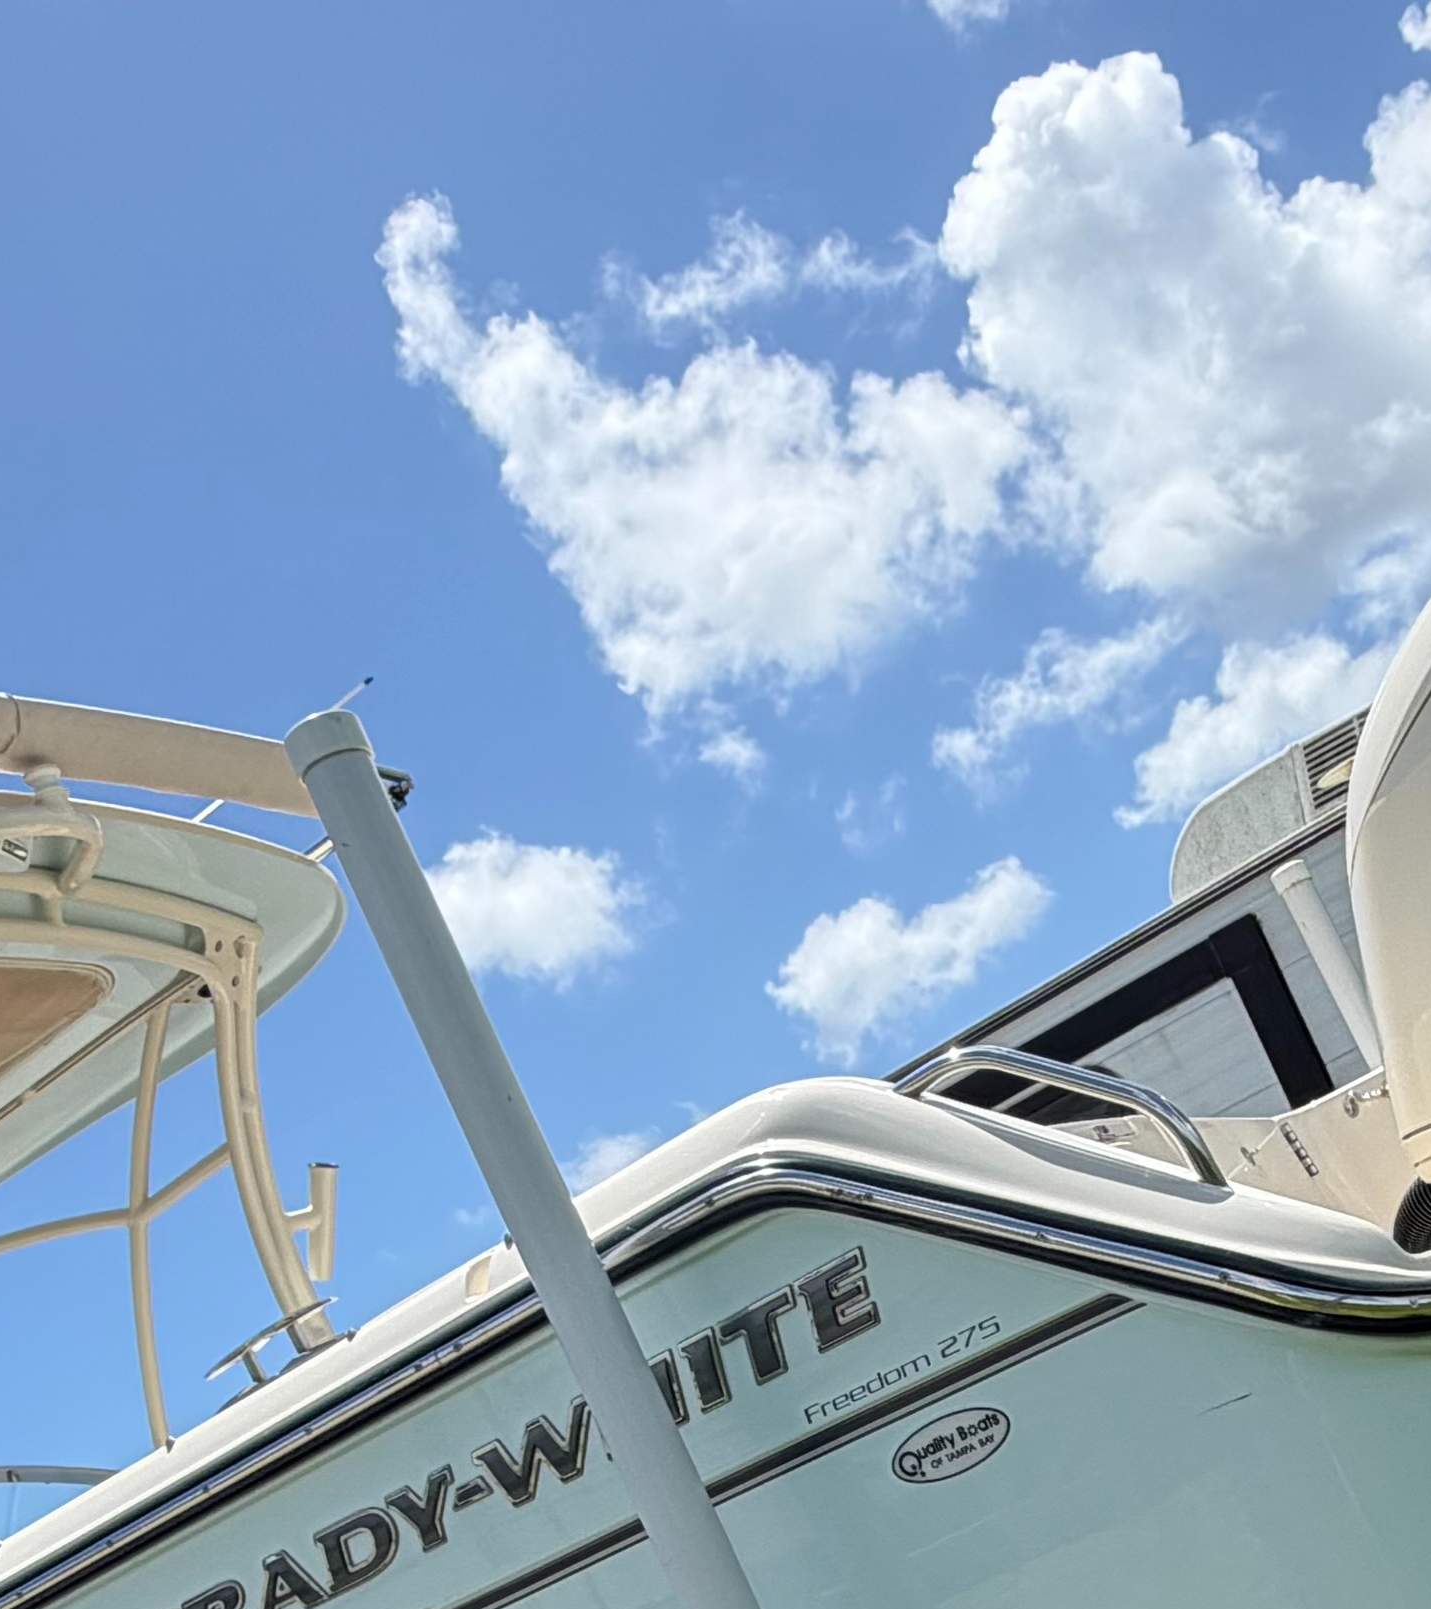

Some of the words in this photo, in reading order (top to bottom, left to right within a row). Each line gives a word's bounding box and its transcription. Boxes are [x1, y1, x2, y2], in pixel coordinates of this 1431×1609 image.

[804, 1354, 931, 1424] Freedom
[937, 1315, 1000, 1359] 275
[898, 1433, 956, 1477] Quality
[956, 1413, 1000, 1441] Boats
[930, 1456, 943, 1469] OF
[945, 1443, 977, 1462] TAMPA
[977, 1433, 995, 1448] BAY
